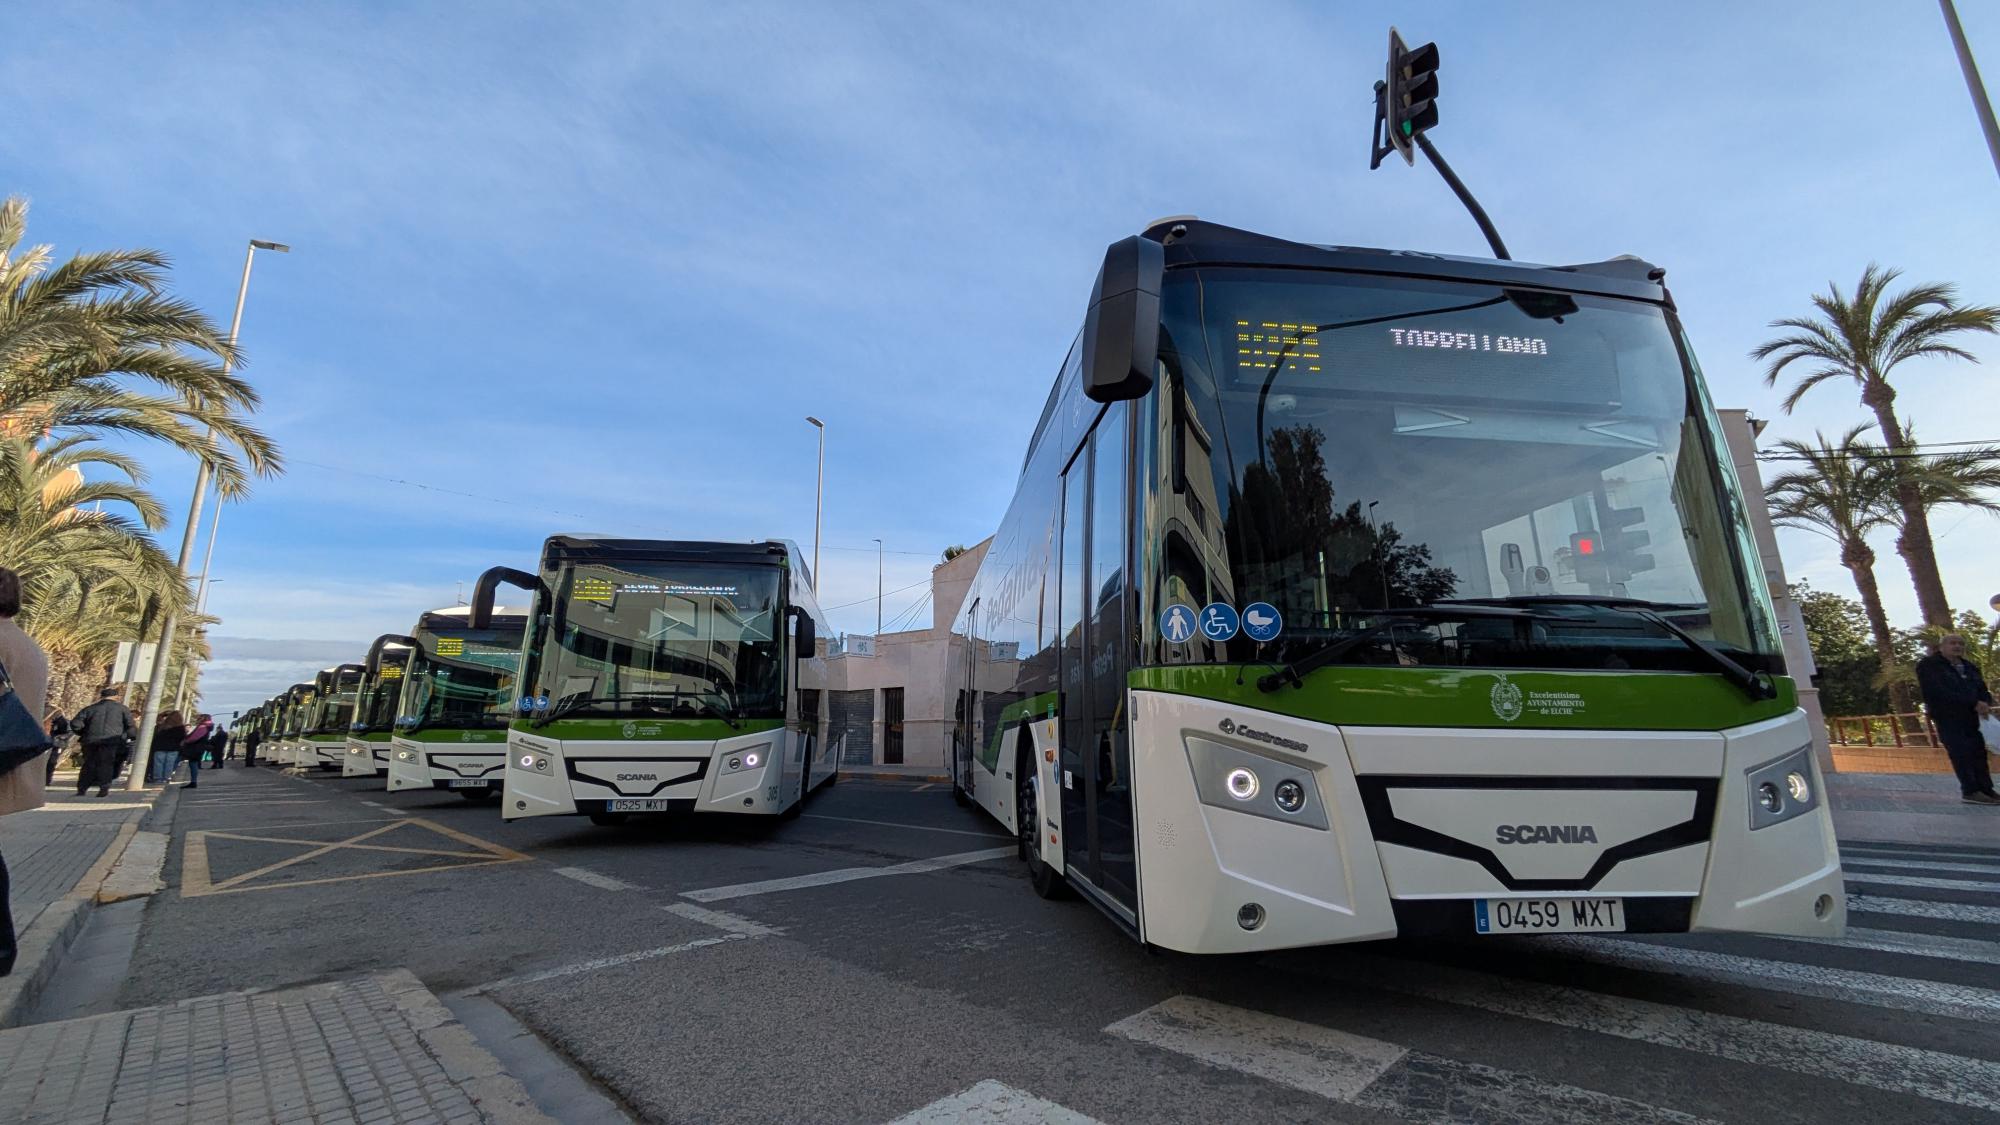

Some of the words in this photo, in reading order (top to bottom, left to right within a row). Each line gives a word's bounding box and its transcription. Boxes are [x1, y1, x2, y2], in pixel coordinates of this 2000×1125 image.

[1527, 699, 1585, 707] AYUNTAMIENTO
[1540, 707, 1550, 715] de
[1550, 707, 1574, 715] ELCHE
[616, 773, 658, 781] SCANIA
[615, 800, 641, 810] 0525
[645, 800, 664, 810] MXT
[1496, 824, 1598, 844] SCANIA
[1497, 901, 1560, 929] 0459
[1571, 900, 1617, 927] MXT
